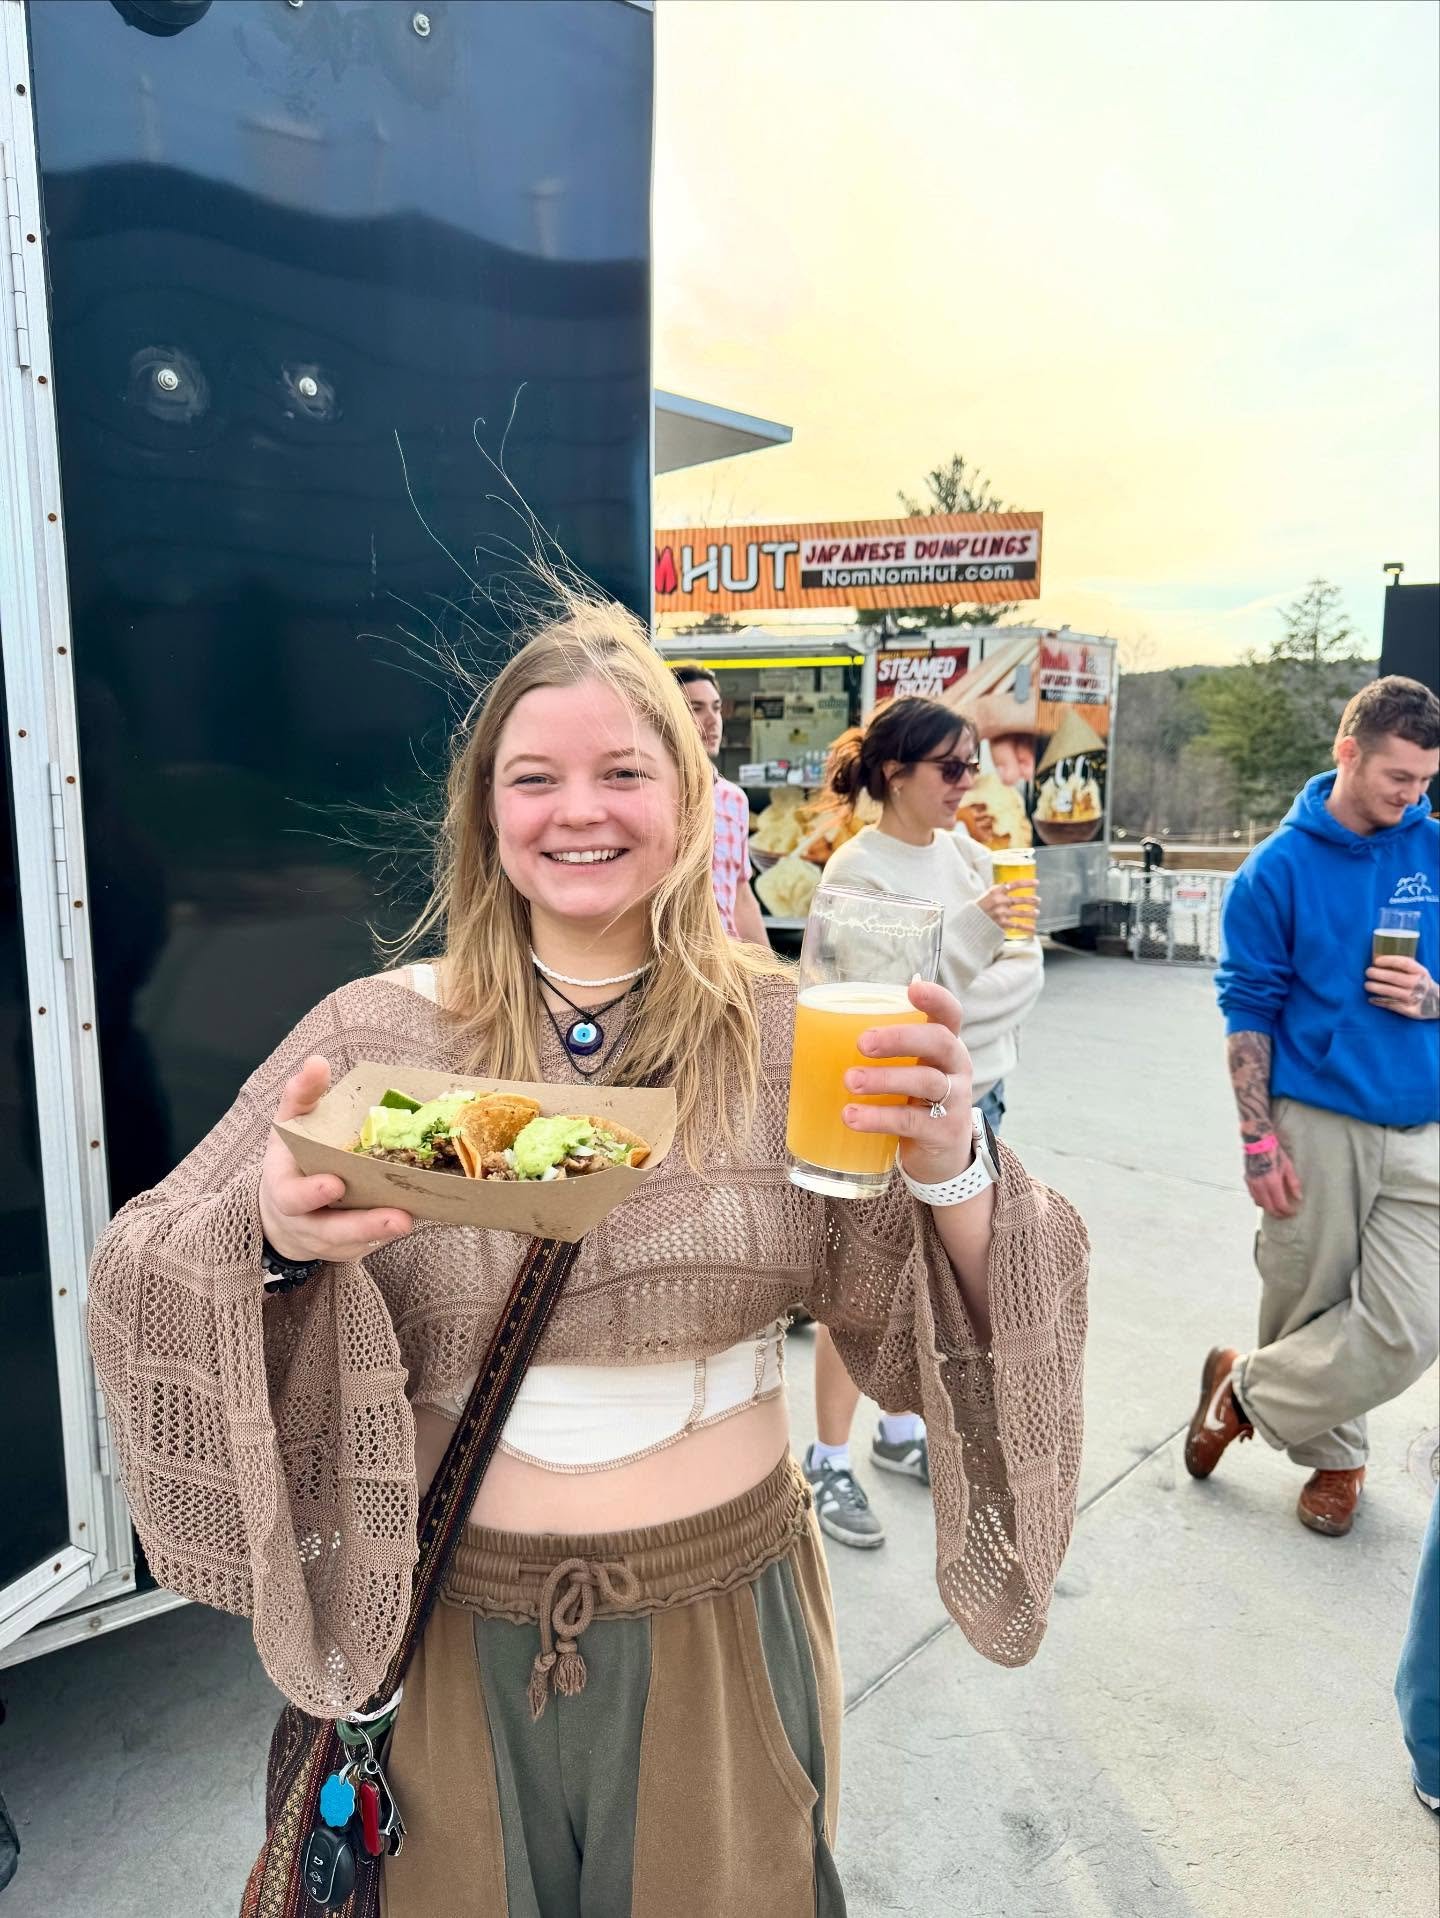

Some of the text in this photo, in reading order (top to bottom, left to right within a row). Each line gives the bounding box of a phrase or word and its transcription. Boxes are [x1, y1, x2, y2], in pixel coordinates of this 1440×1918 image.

[806, 536, 1031, 564] JAPANESE DUMPLINGS
[682, 543, 798, 593] HUT
[822, 564, 1014, 587] NomNomHut.com
[878, 656, 957, 681] STEAMED
